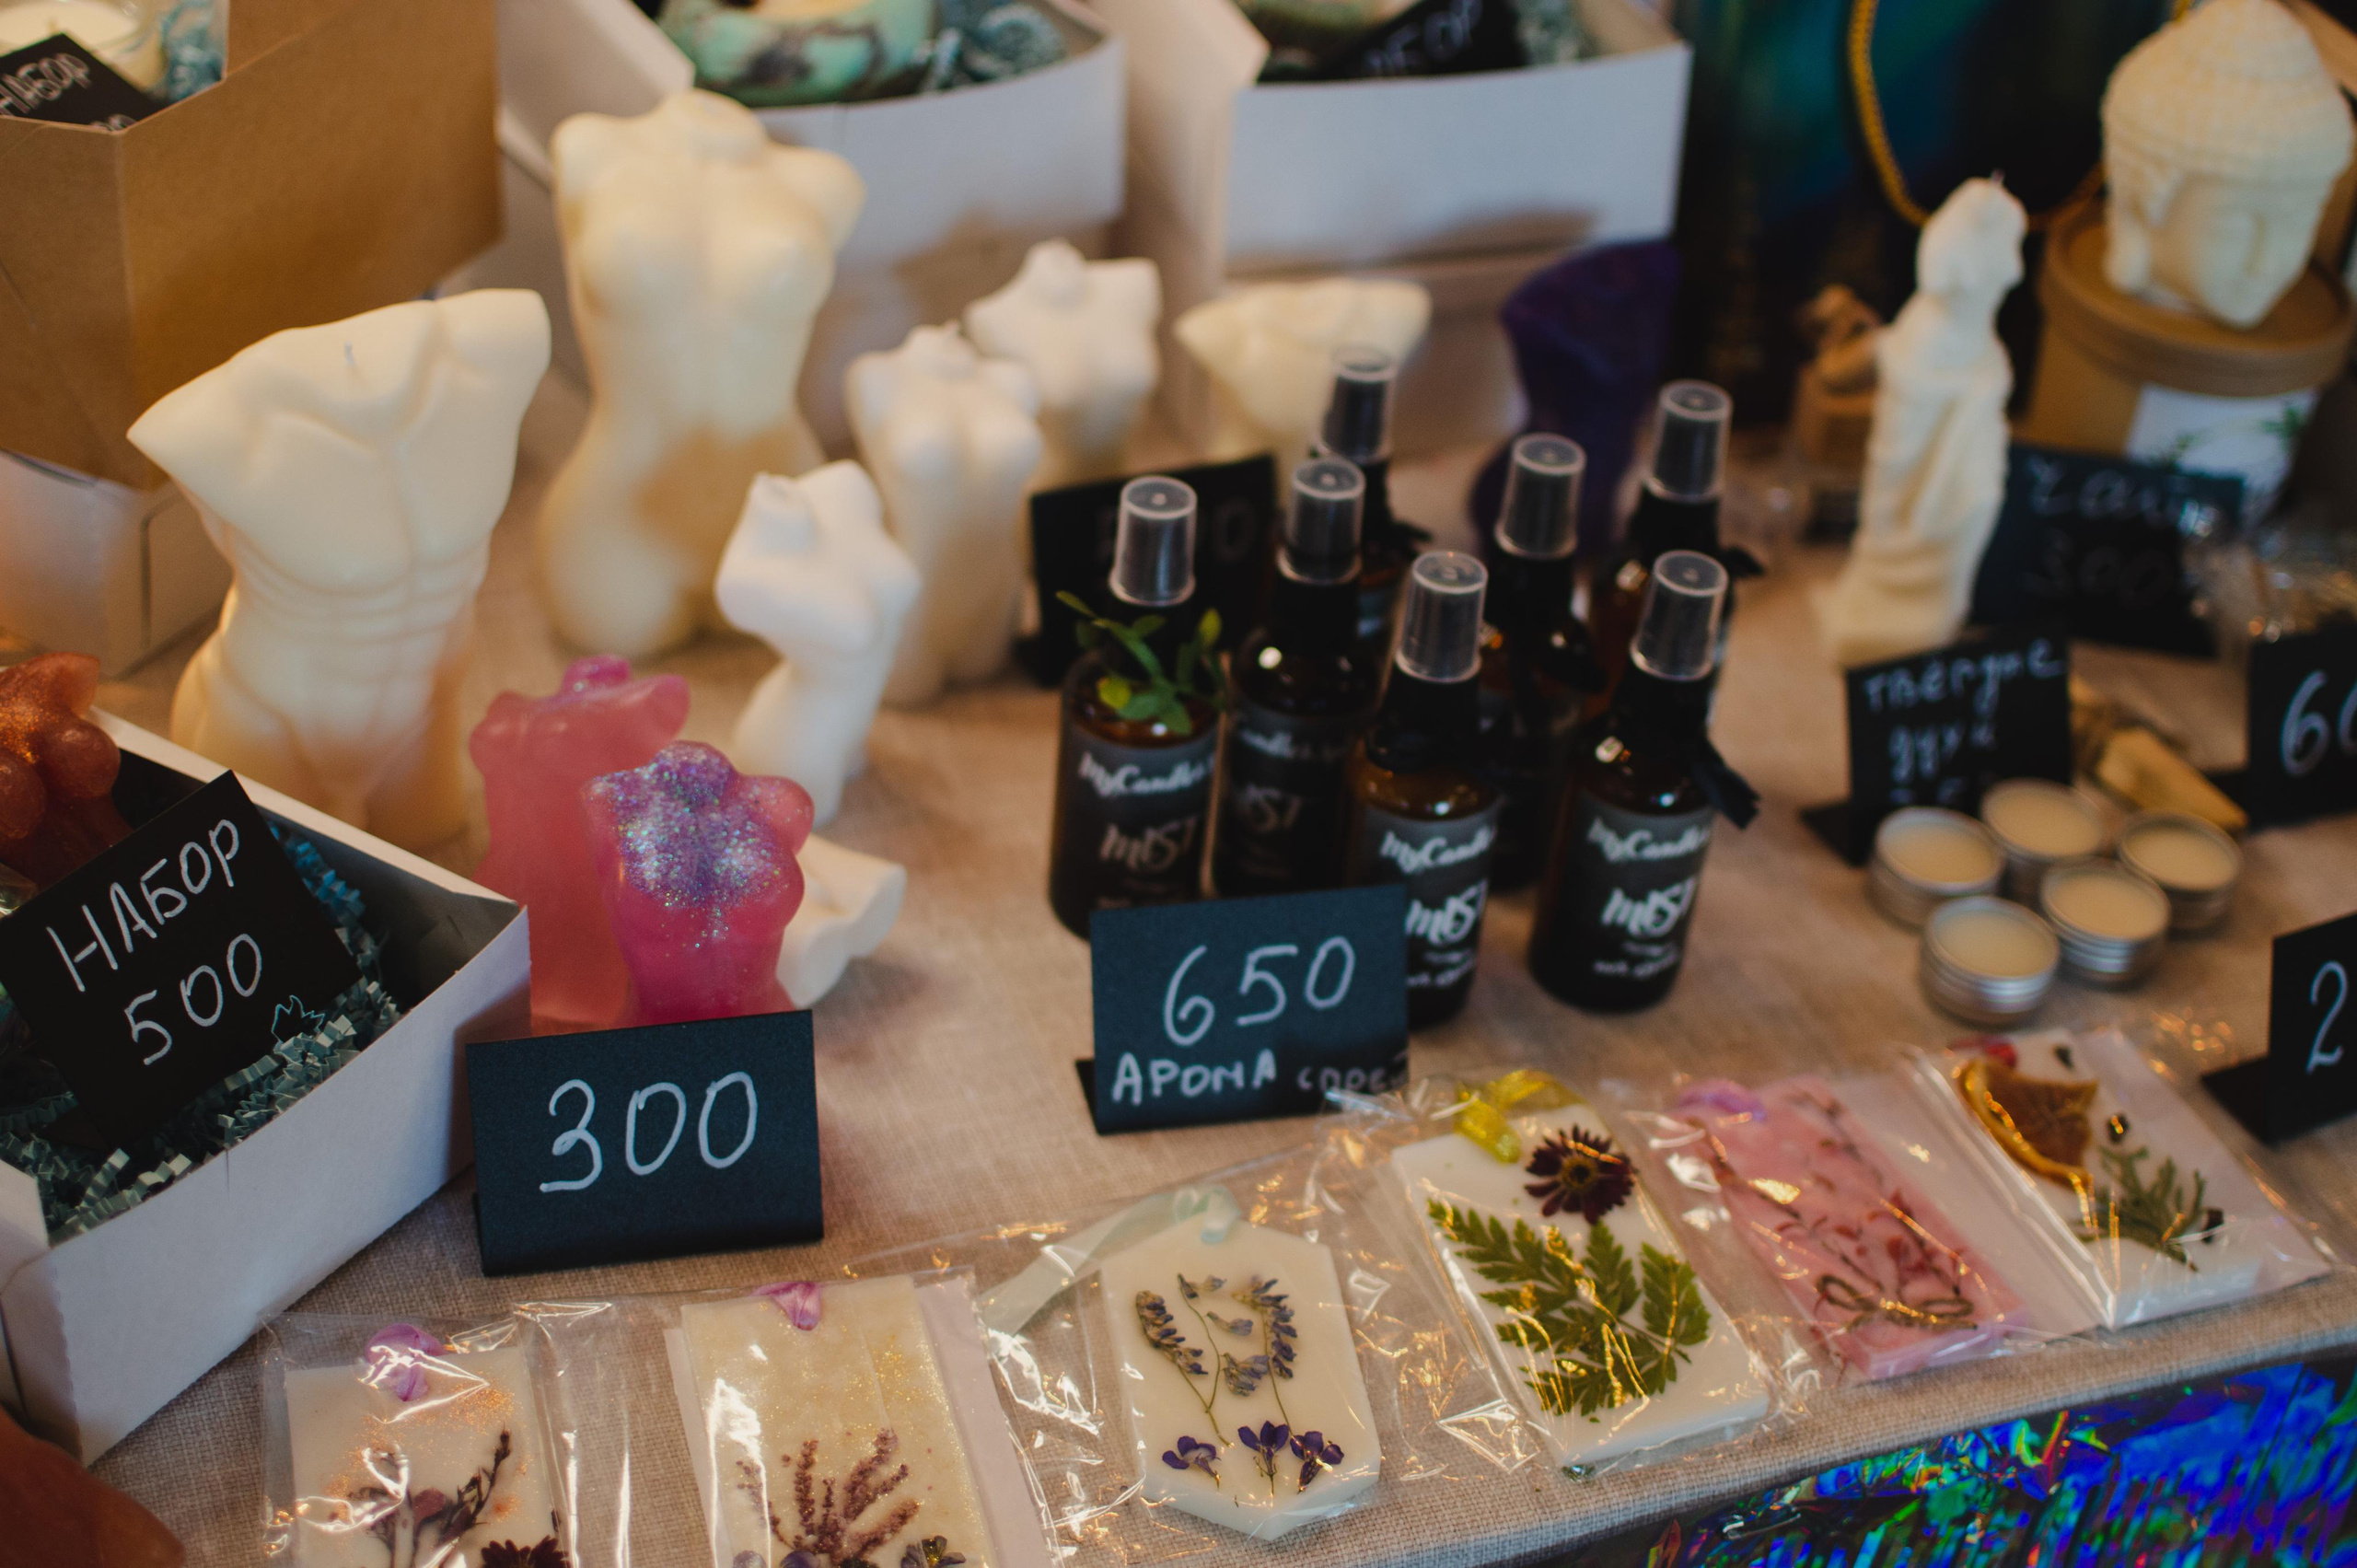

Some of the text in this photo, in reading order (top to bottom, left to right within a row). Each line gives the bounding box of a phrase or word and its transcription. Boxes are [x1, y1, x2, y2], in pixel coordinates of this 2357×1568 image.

[46, 819, 239, 993] НАБОР
[124, 934, 262, 1066] 500
[1163, 935, 1356, 1047] 650
[540, 1070, 759, 1193] 300
[1111, 1048, 1278, 1108] АРОМА
